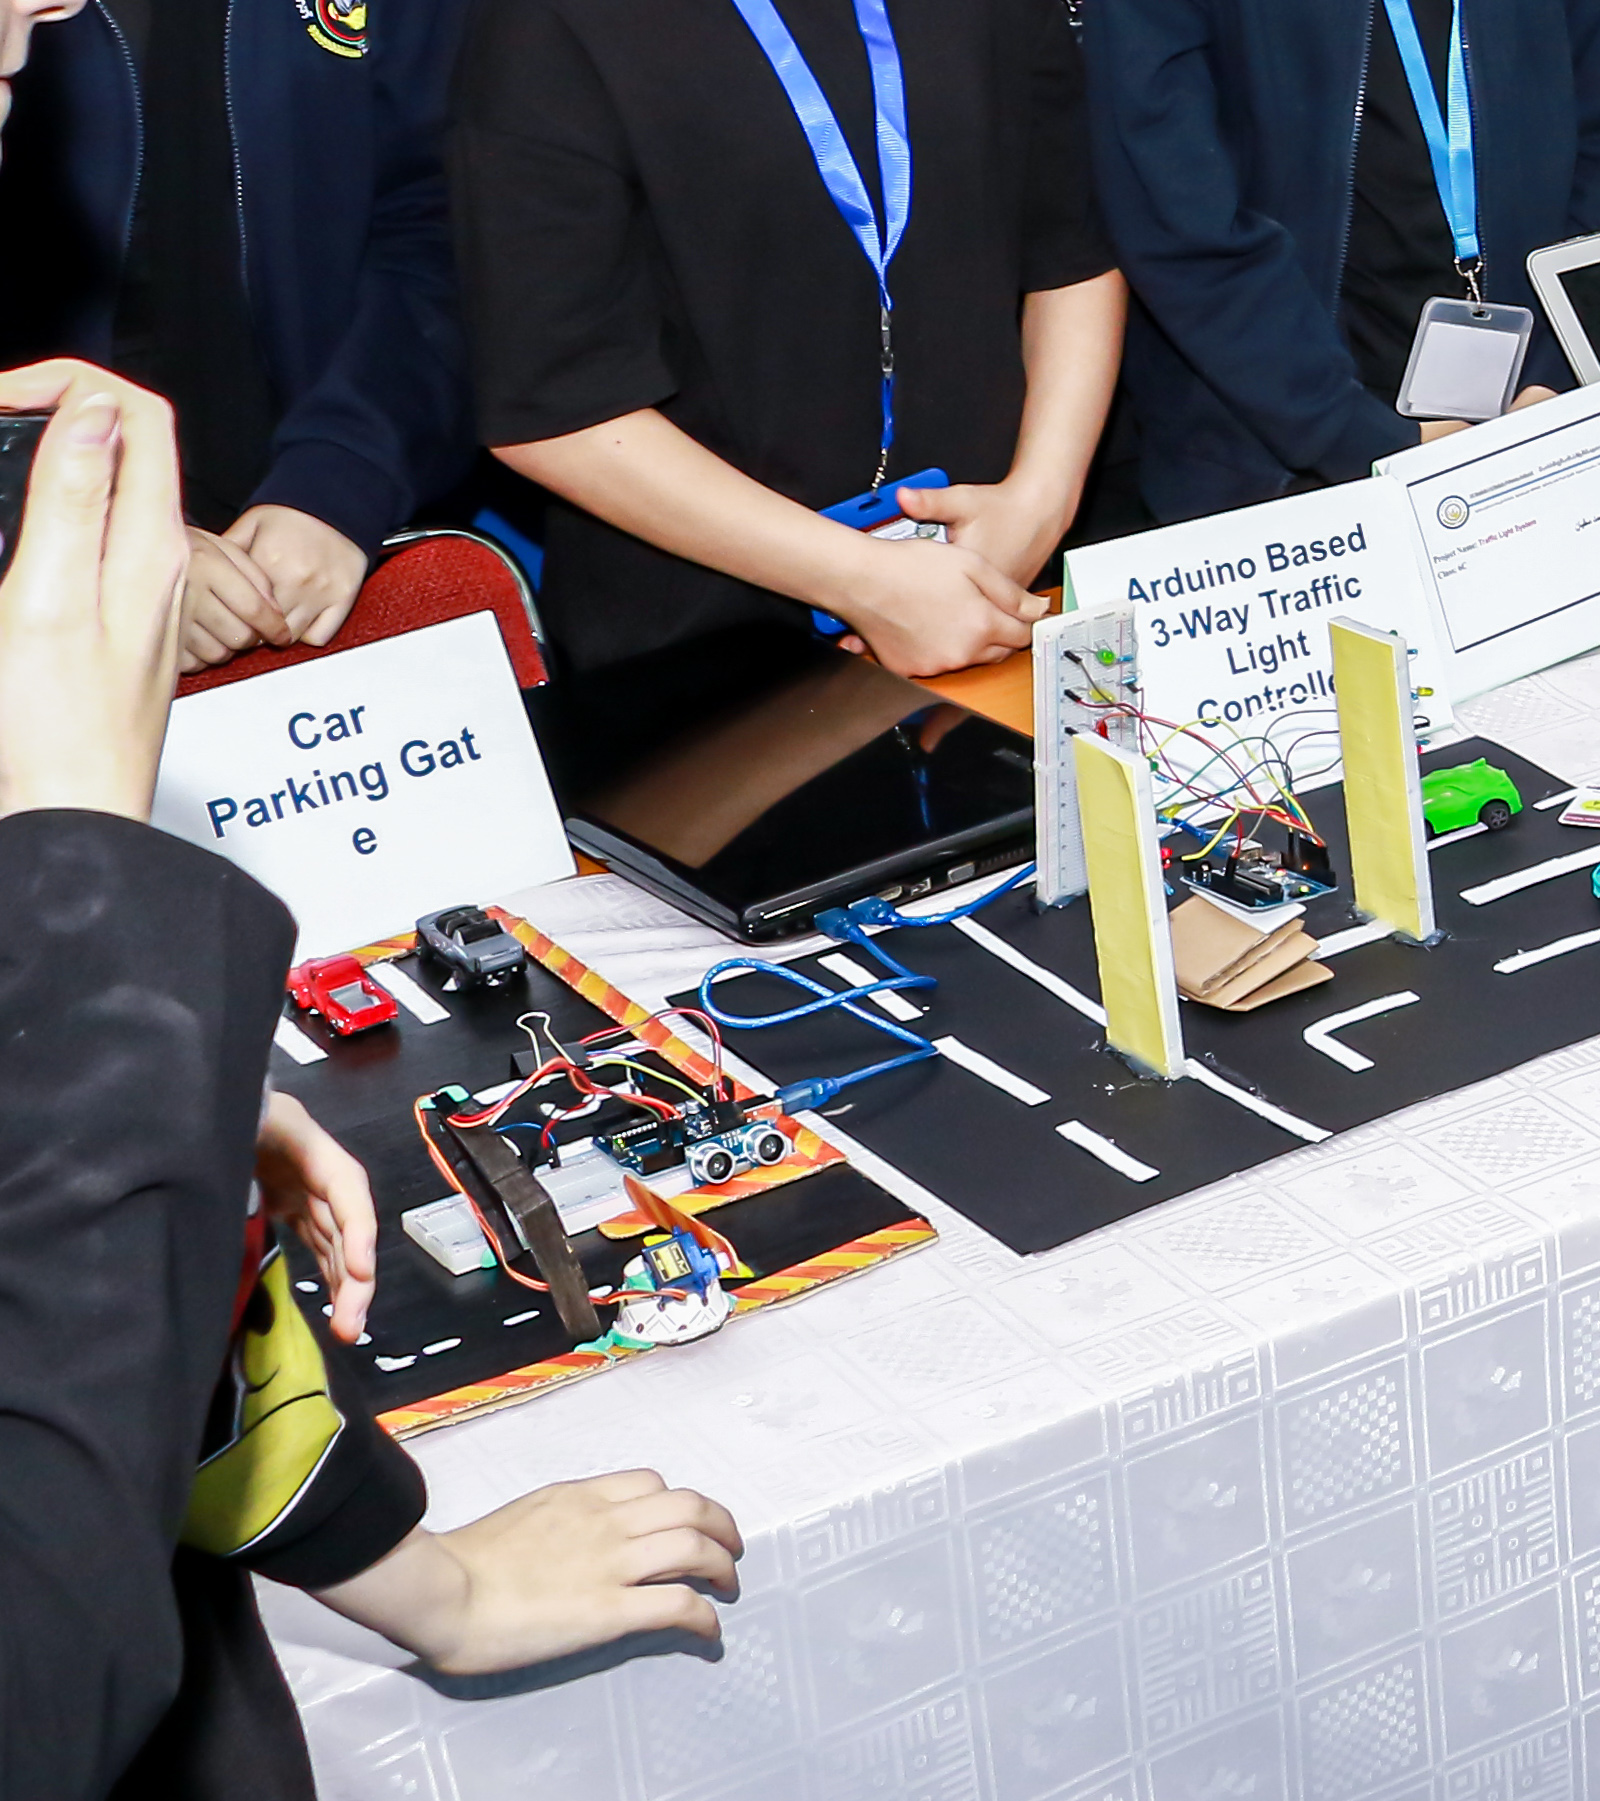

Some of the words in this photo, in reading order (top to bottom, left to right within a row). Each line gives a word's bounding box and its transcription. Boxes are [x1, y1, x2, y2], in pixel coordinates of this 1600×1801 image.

[1127, 560, 1256, 603] Arduino
[1265, 523, 1367, 572] Based
[1151, 604, 1249, 647] 3-Way
[1258, 574, 1362, 619] Traffic
[1226, 630, 1310, 674] Light
[288, 705, 365, 750] Car
[206, 762, 389, 839] Parking
[400, 726, 481, 777] Gat
[352, 827, 378, 855] e
